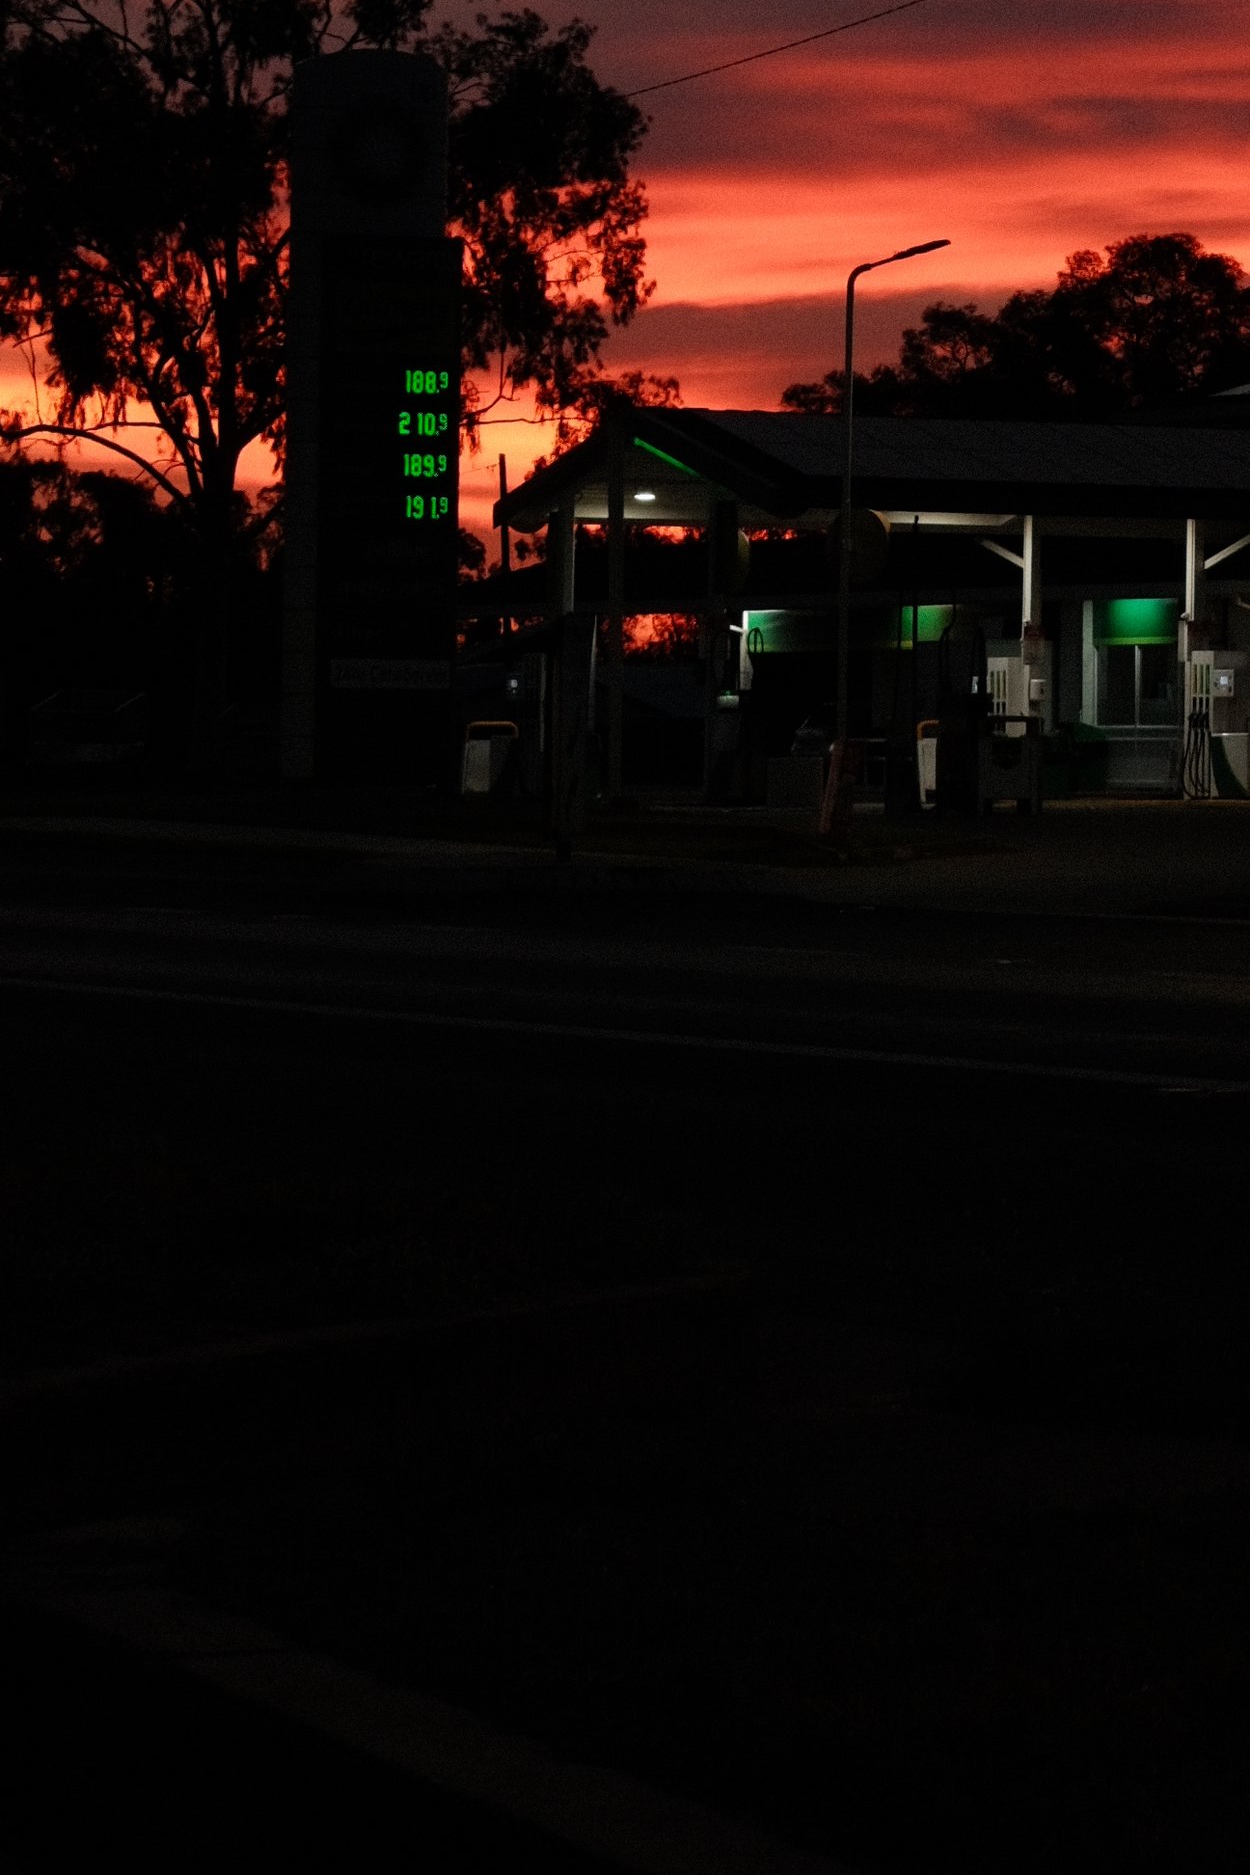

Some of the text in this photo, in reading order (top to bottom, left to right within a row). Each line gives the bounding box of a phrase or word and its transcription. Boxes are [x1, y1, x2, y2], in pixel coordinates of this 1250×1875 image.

[405, 370, 449, 394] 188.9
[403, 453, 447, 478] 189.9
[406, 495, 449, 520] 191.9
